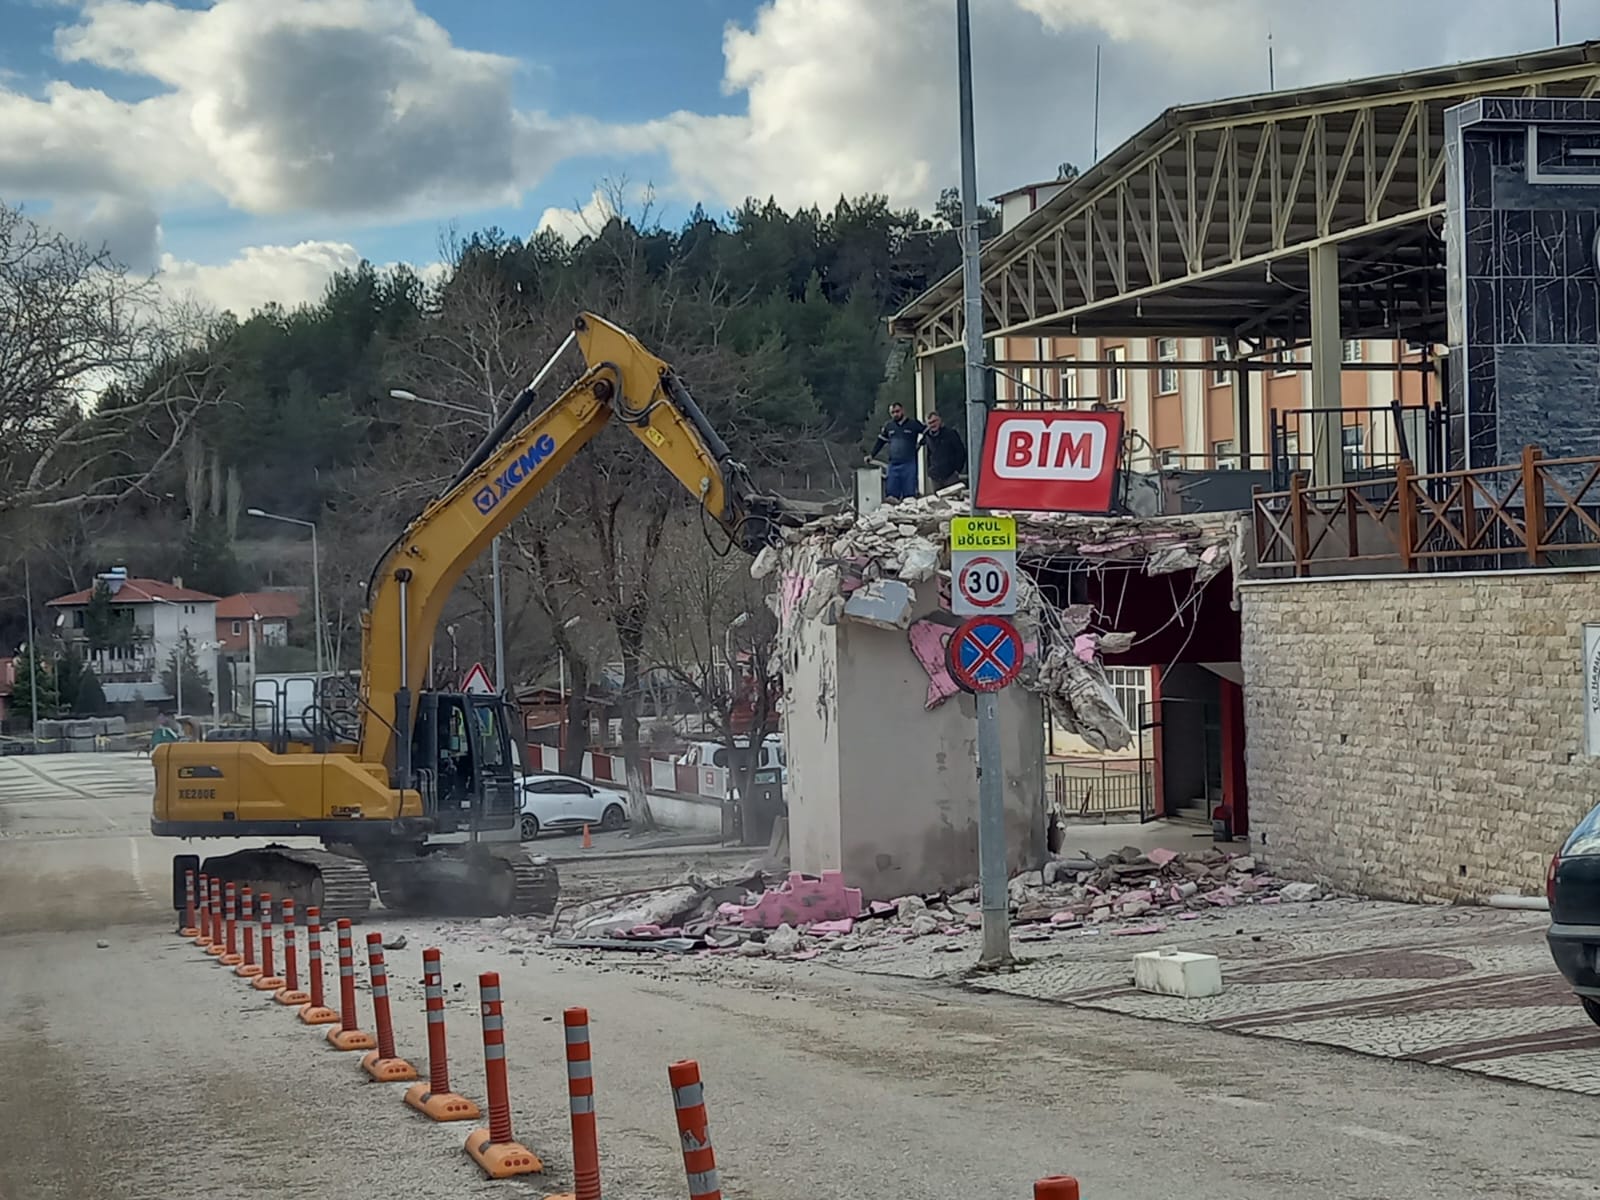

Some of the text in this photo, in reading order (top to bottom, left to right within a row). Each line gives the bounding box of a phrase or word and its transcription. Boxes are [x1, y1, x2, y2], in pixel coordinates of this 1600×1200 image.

[495, 434, 555, 498] XCMG
[967, 521, 1001, 531] OKUL
[958, 533, 1010, 545] BÖLGESİ
[969, 571, 999, 593] 30
